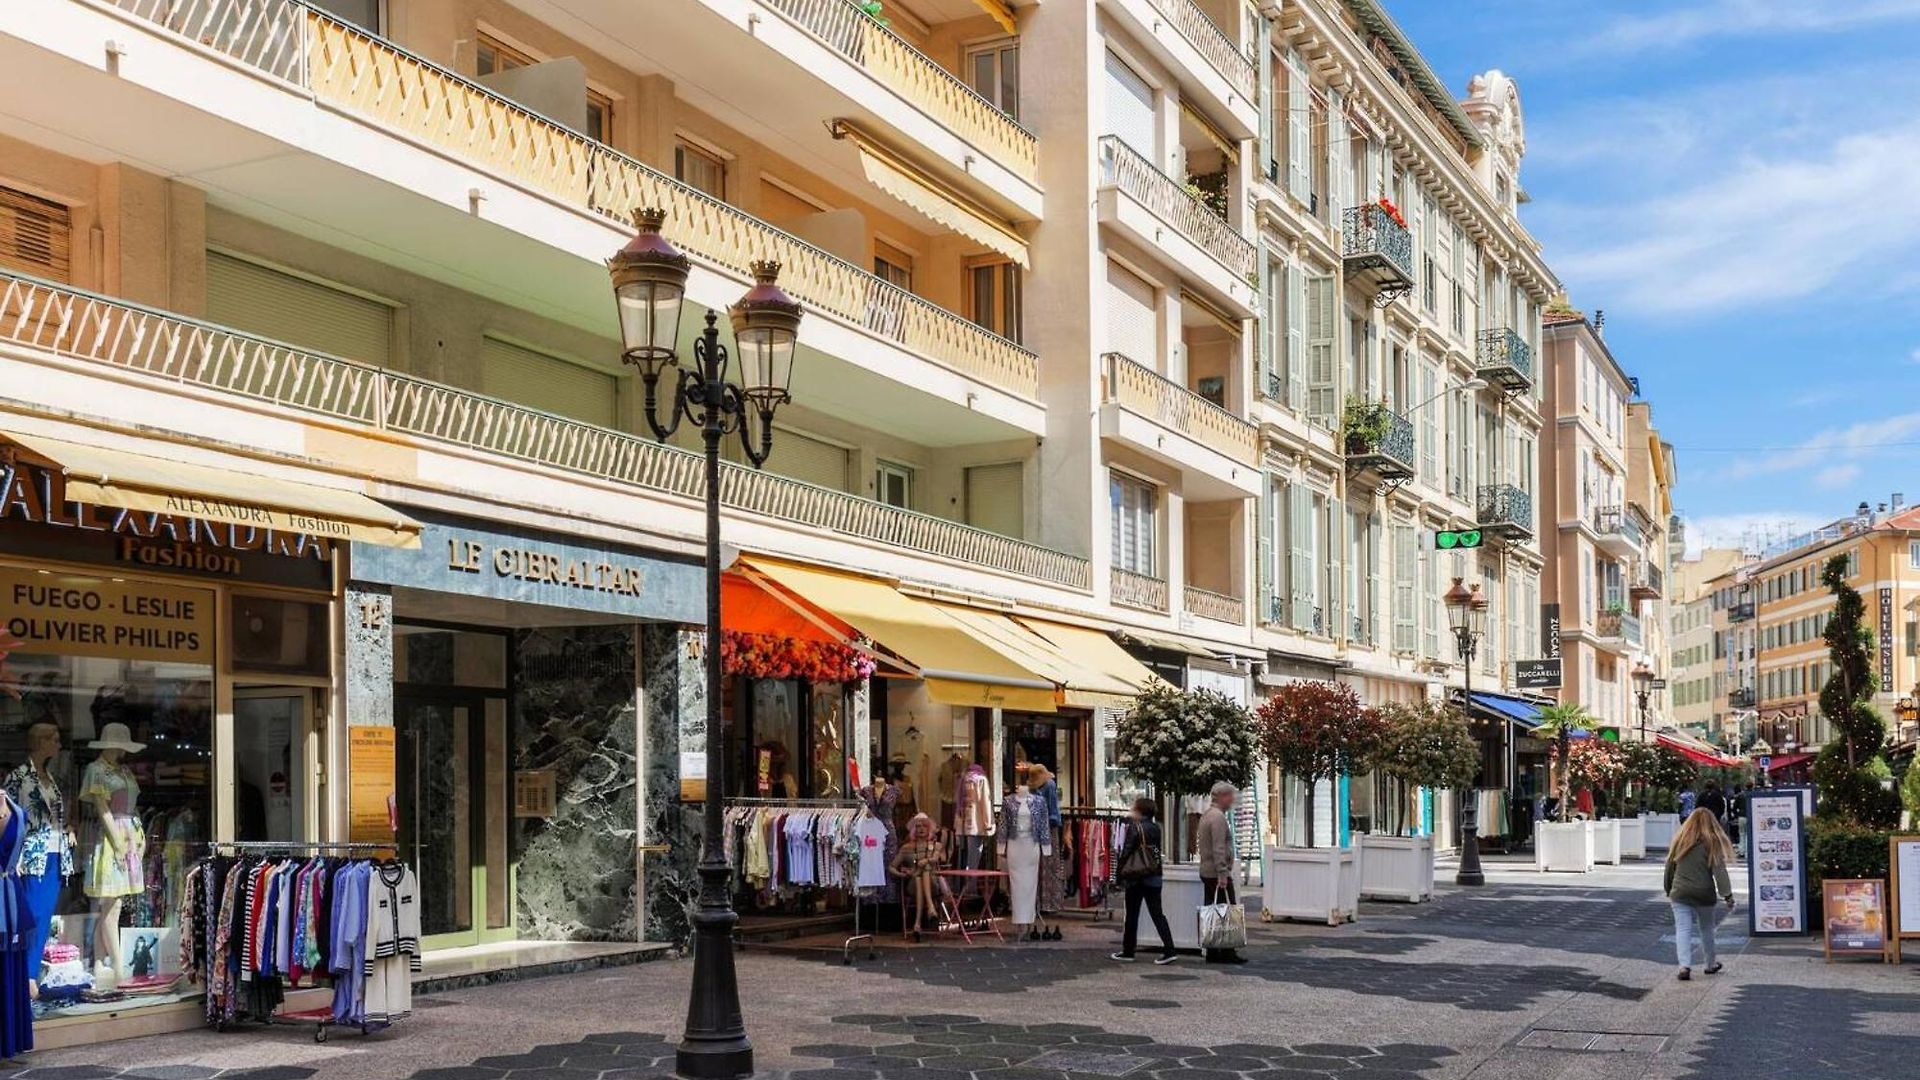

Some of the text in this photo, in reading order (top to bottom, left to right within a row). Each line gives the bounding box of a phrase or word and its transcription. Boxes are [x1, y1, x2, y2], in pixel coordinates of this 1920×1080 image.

[166, 494, 351, 536] ALEXANDRA Fashion
[122, 537, 241, 575] Fashion
[449, 539, 642, 597] LE GIBRALTAR
[13, 584, 101, 611] FUEGO
[122, 595, 195, 620] LESLIE
[360, 601, 383, 629] 12
[1881, 589, 1891, 630] HOTEL
[8, 617, 199, 651] OLIVIER PHILIPS
[1518, 670, 1560, 678] ZUCCARELLI
